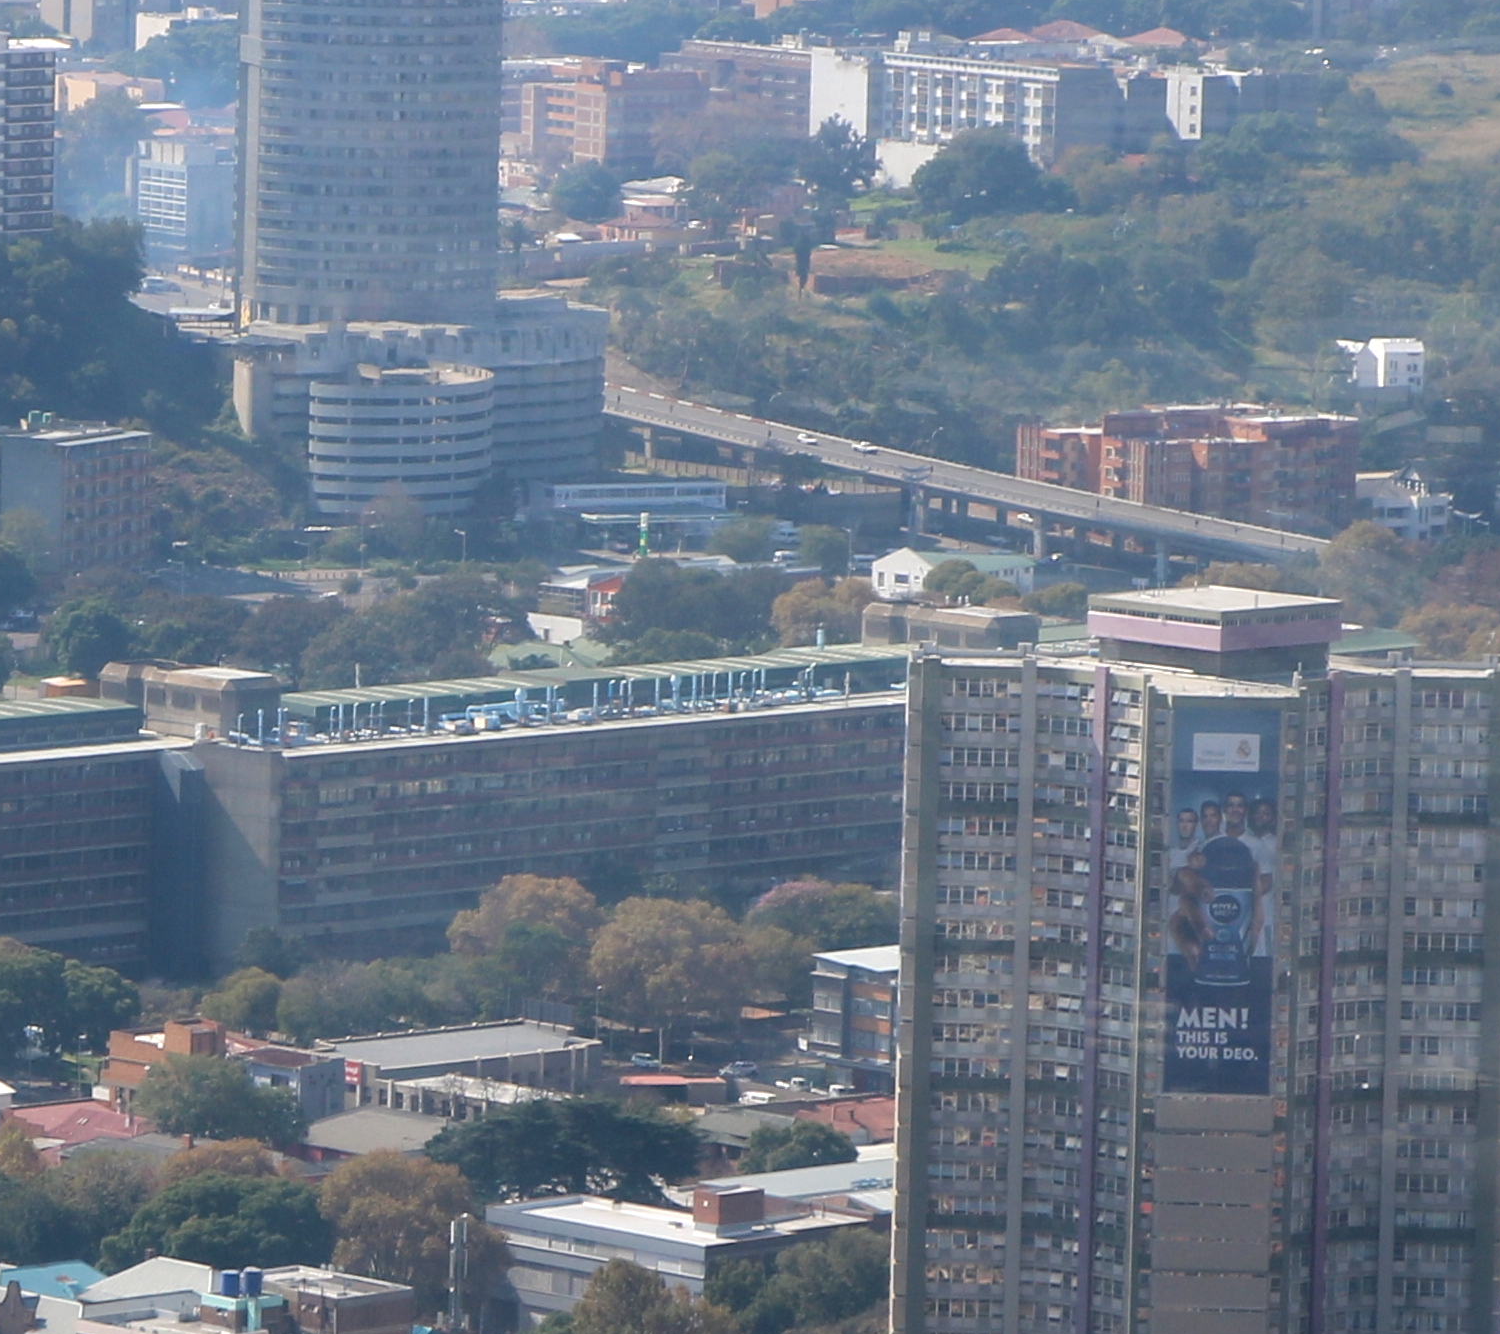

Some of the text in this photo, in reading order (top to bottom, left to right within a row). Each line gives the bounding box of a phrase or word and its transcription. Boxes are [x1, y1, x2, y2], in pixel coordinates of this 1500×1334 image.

[1177, 1007, 1249, 1029] MEN!
[1176, 1031, 1228, 1044] THIS IS
[1176, 1046, 1258, 1060] YOUR DEO.
